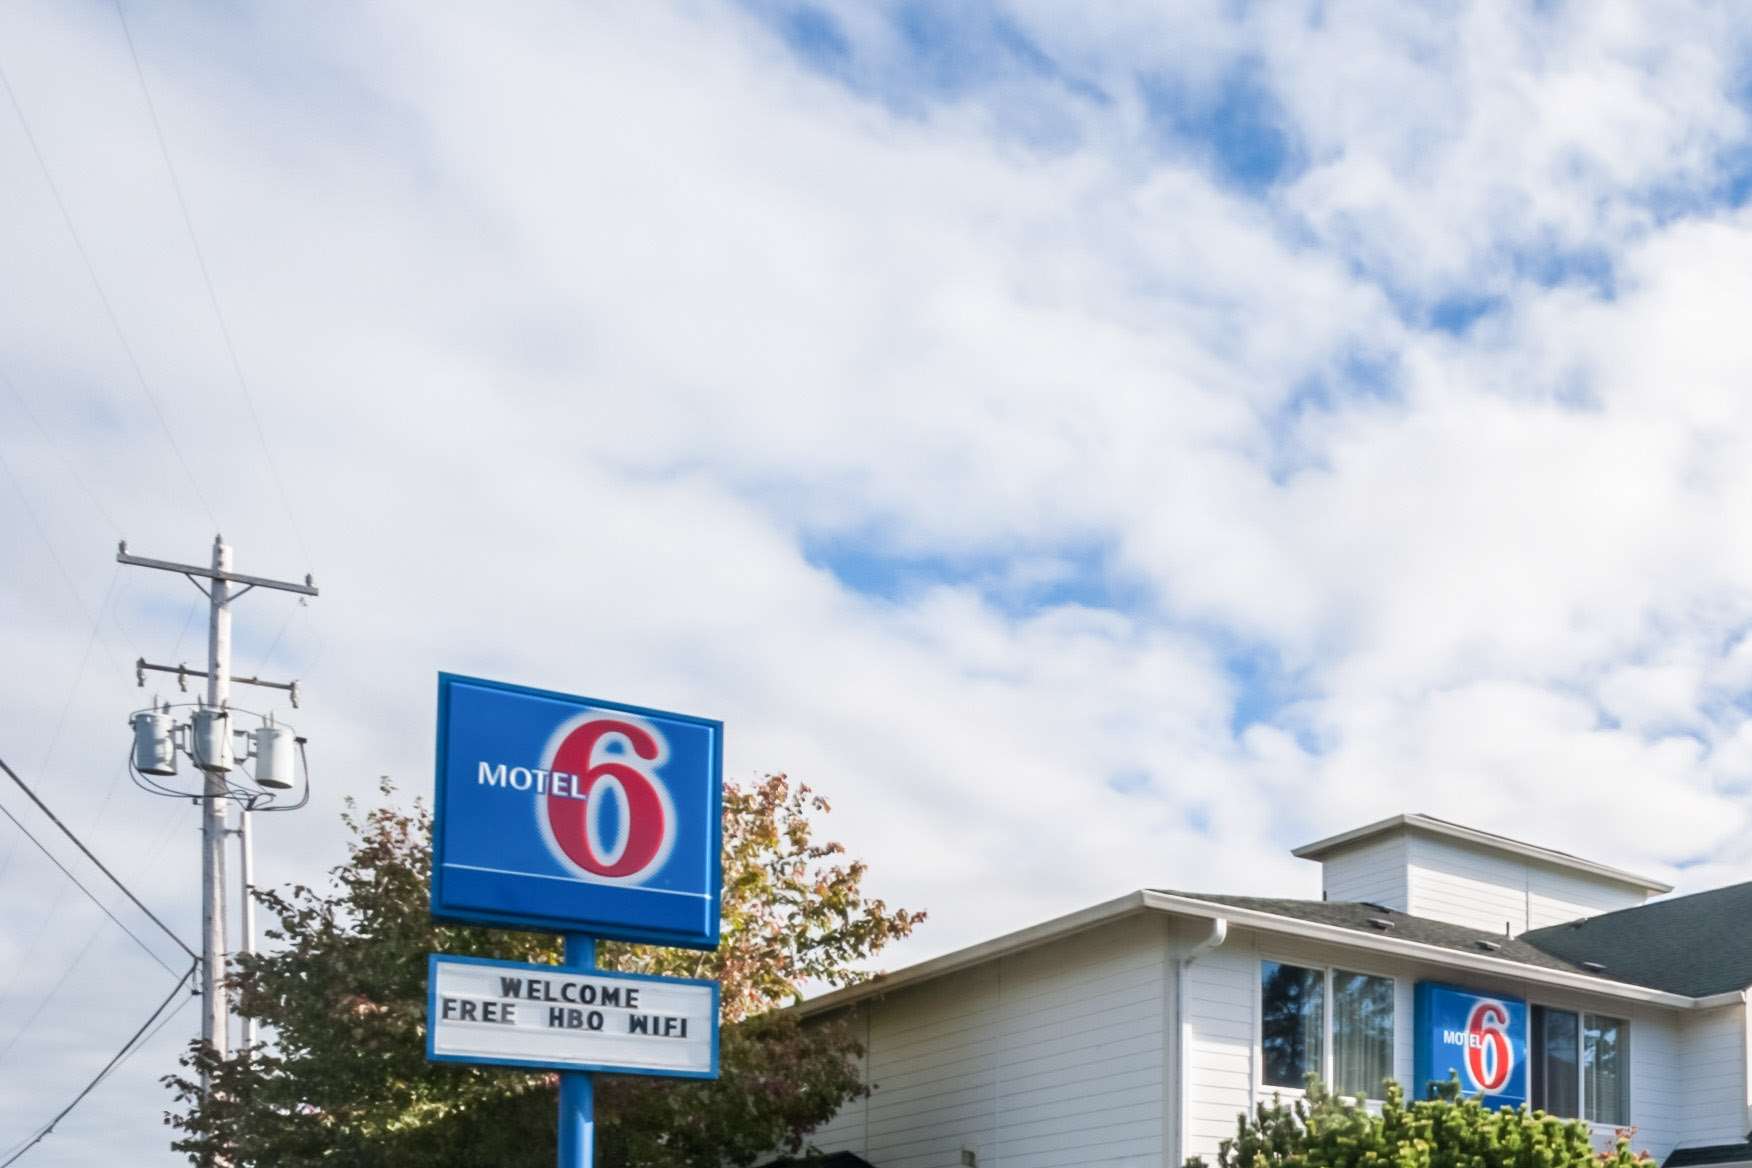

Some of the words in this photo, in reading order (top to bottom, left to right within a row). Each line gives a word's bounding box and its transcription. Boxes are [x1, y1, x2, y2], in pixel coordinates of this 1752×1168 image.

[478, 761, 587, 800] MOTEL
[546, 718, 666, 879] 6
[441, 998, 516, 1025] FREE
[548, 1008, 604, 1031] HBO
[628, 1014, 688, 1038] WIFI
[500, 977, 639, 1009] WELCOME
[1443, 1030, 1483, 1049] MOTEL
[1468, 1002, 1510, 1090] 6
